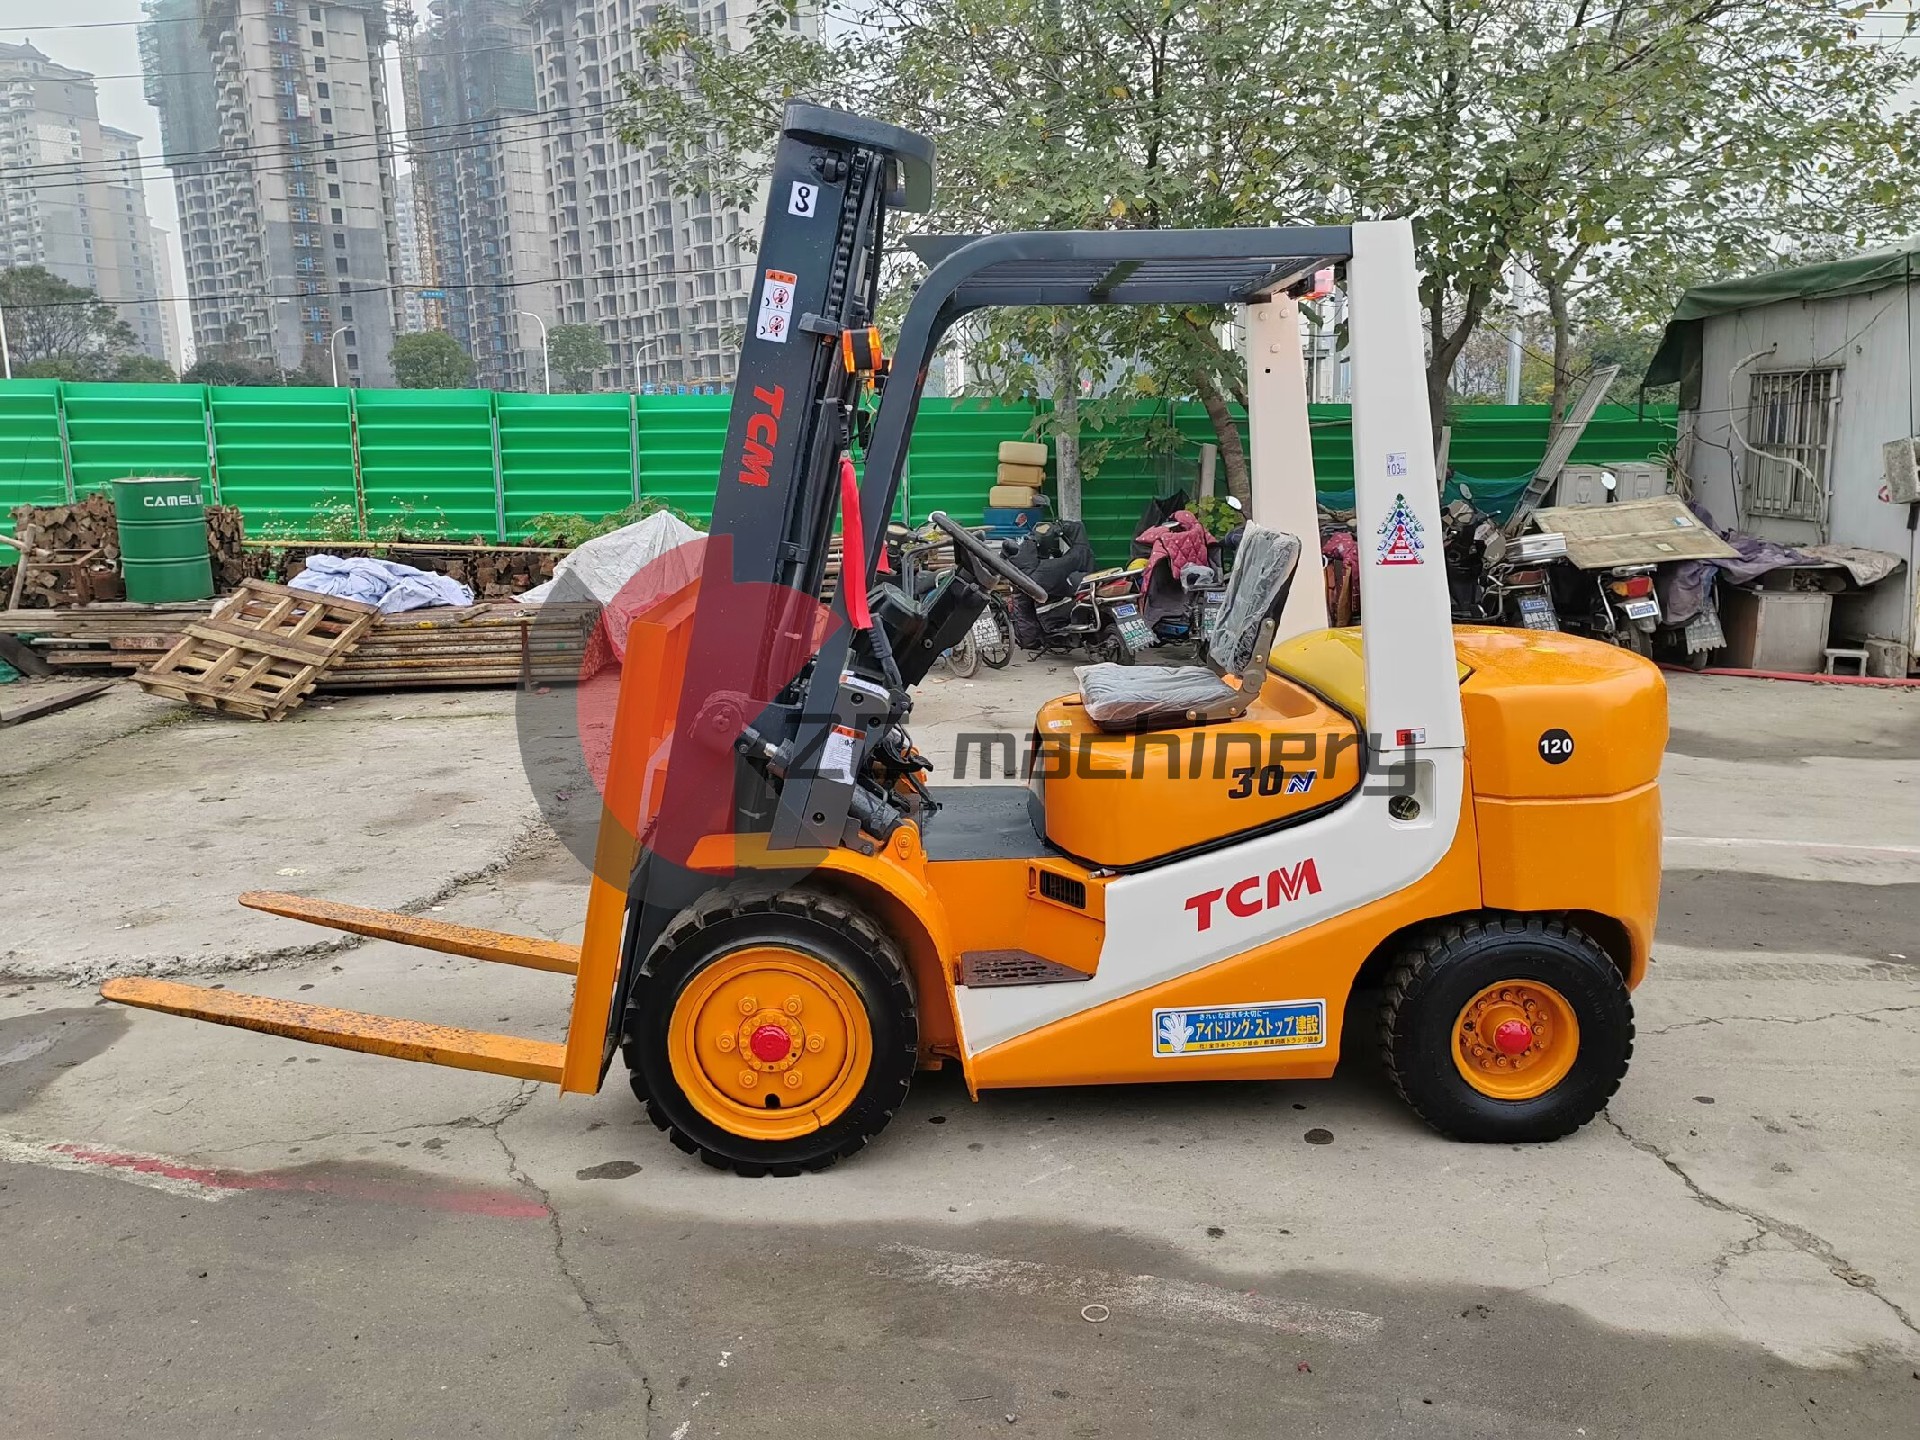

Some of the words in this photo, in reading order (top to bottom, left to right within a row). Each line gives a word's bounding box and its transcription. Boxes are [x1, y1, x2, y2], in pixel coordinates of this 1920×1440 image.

[738, 384, 785, 487] TCM
[1540, 738, 1573, 754] 120
[1184, 858, 1322, 932] TCM
